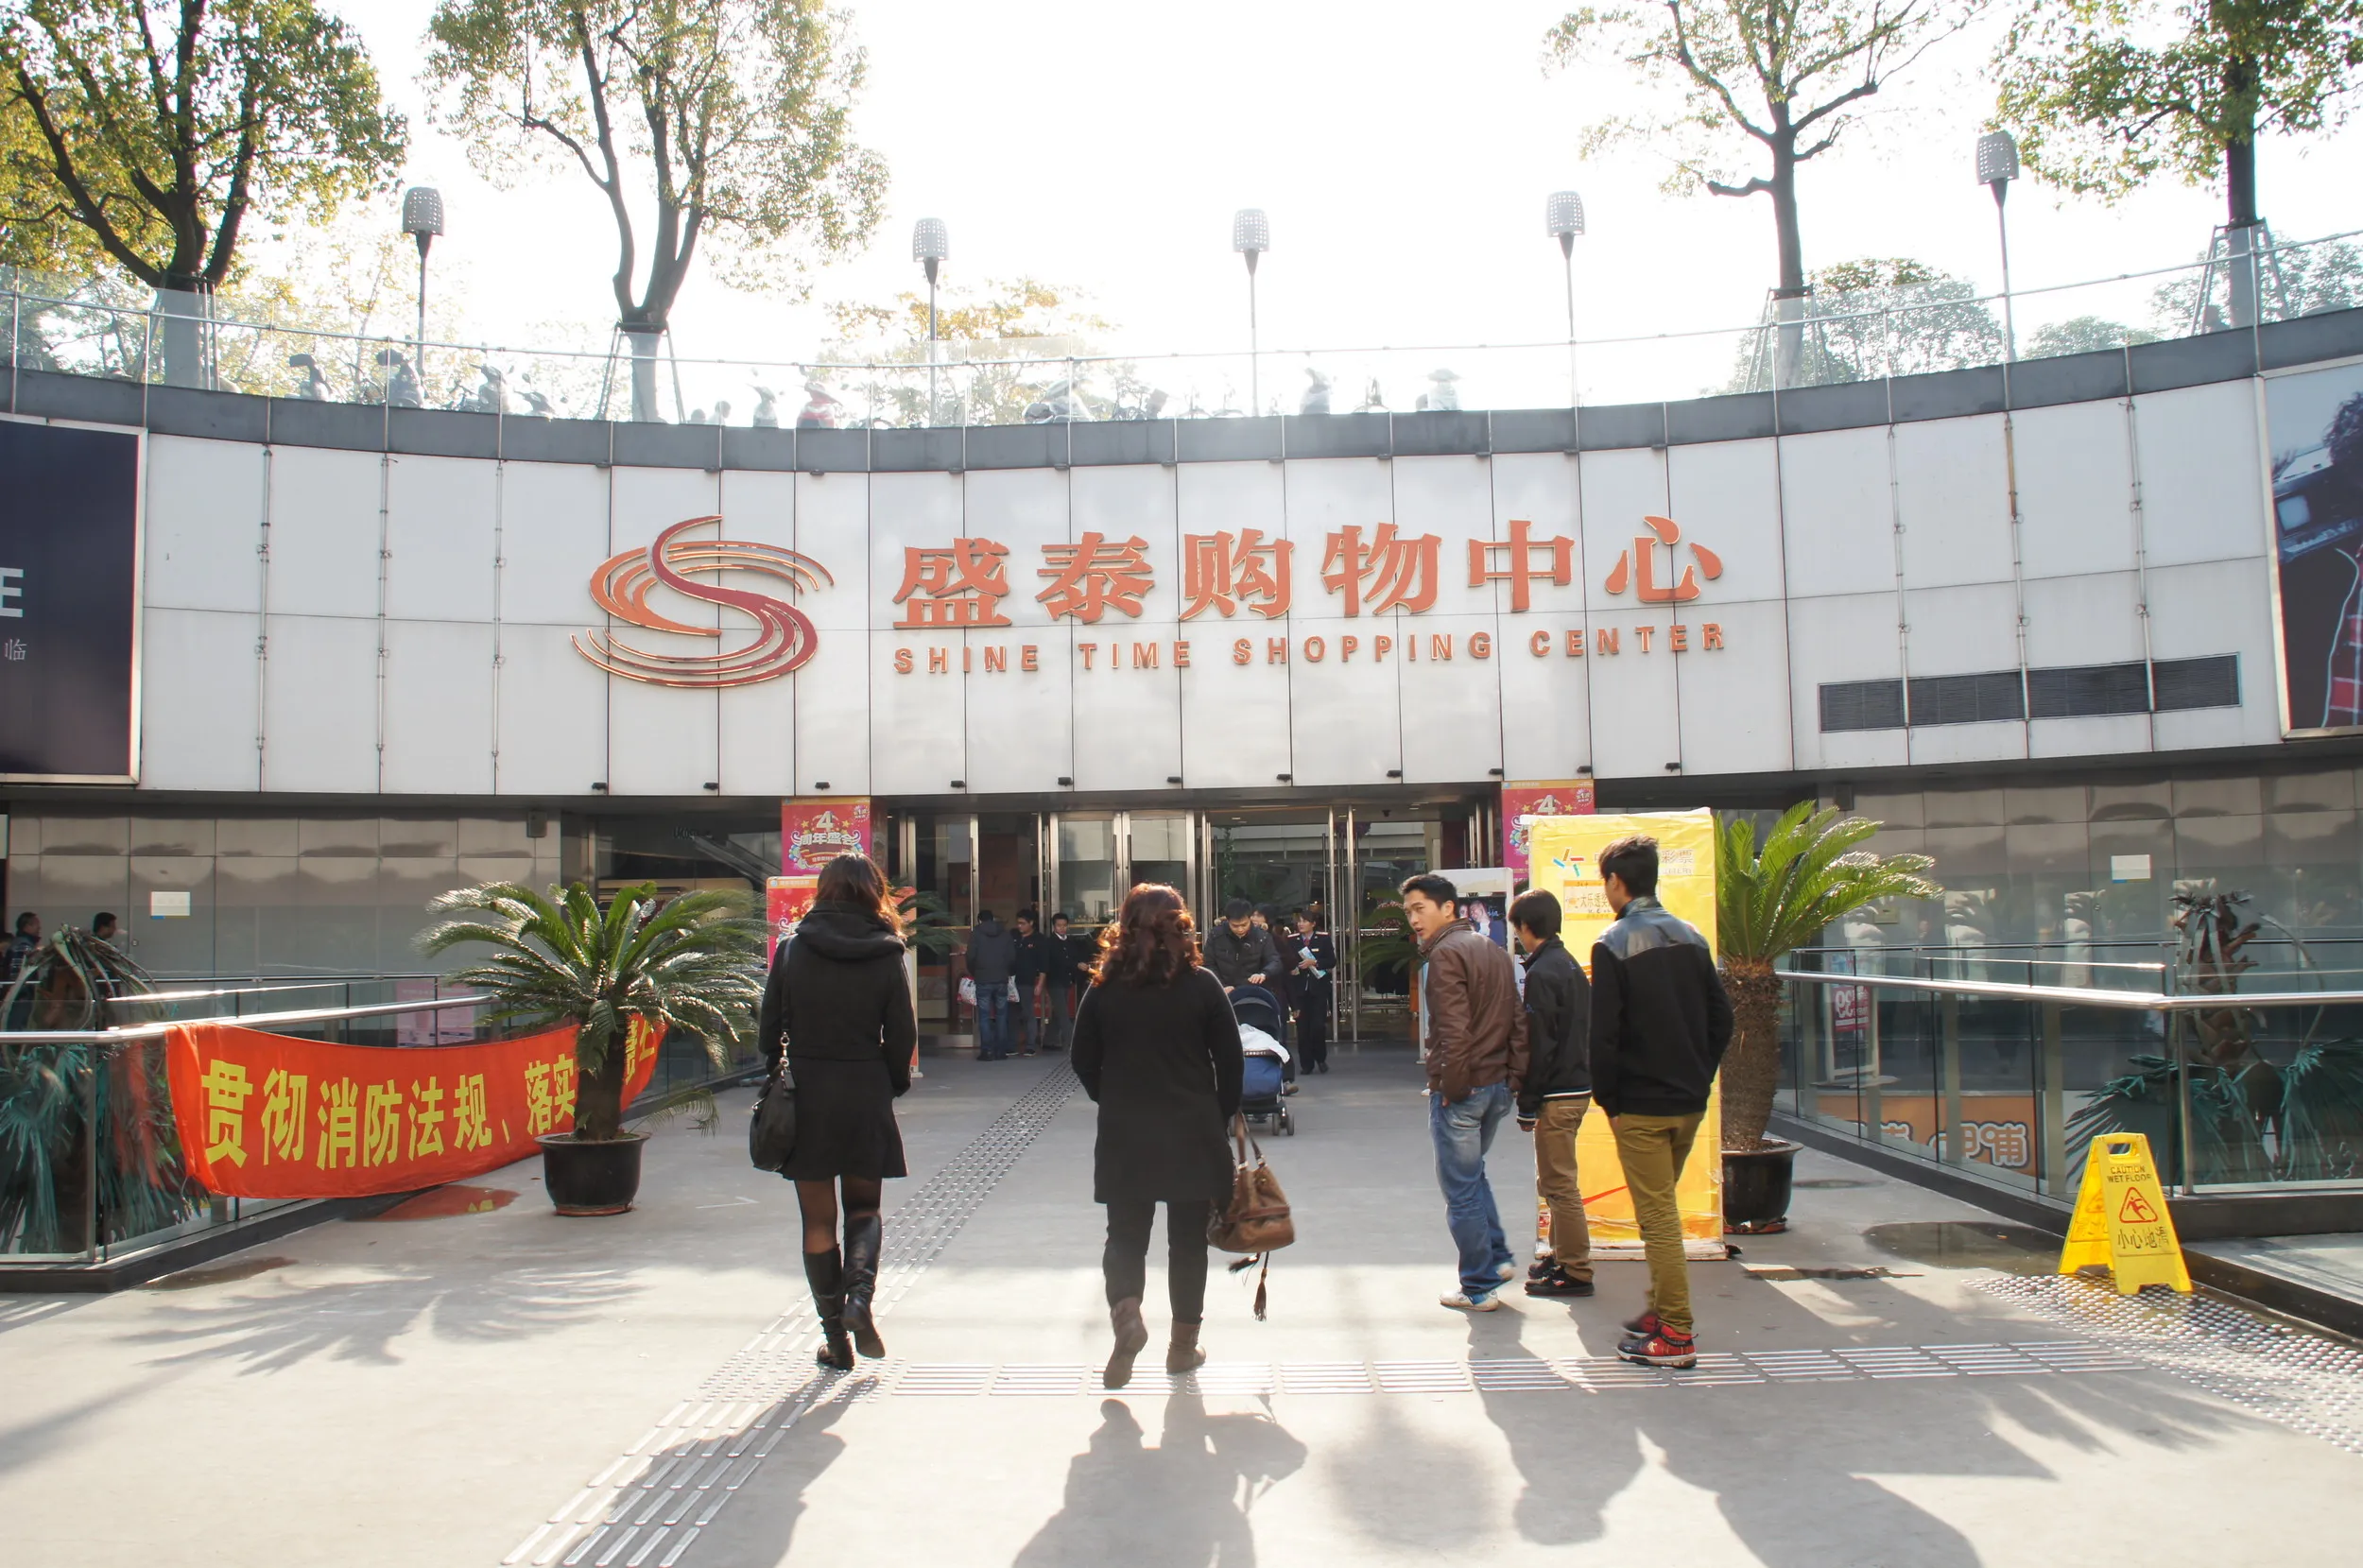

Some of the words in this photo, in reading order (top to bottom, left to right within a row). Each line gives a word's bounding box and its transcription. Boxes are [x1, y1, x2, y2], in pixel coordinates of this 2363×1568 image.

[891, 515, 1723, 629] 盛泰购物中心
[894, 645, 1039, 674] SHINE
[1078, 640, 1191, 669] TIME
[1233, 632, 1492, 665] SHOPPING
[1529, 623, 1724, 657] CENTER
[816, 810, 835, 832] 4
[2107, 1175, 2124, 1183] WET
[2110, 1165, 2146, 1175] CAUTION
